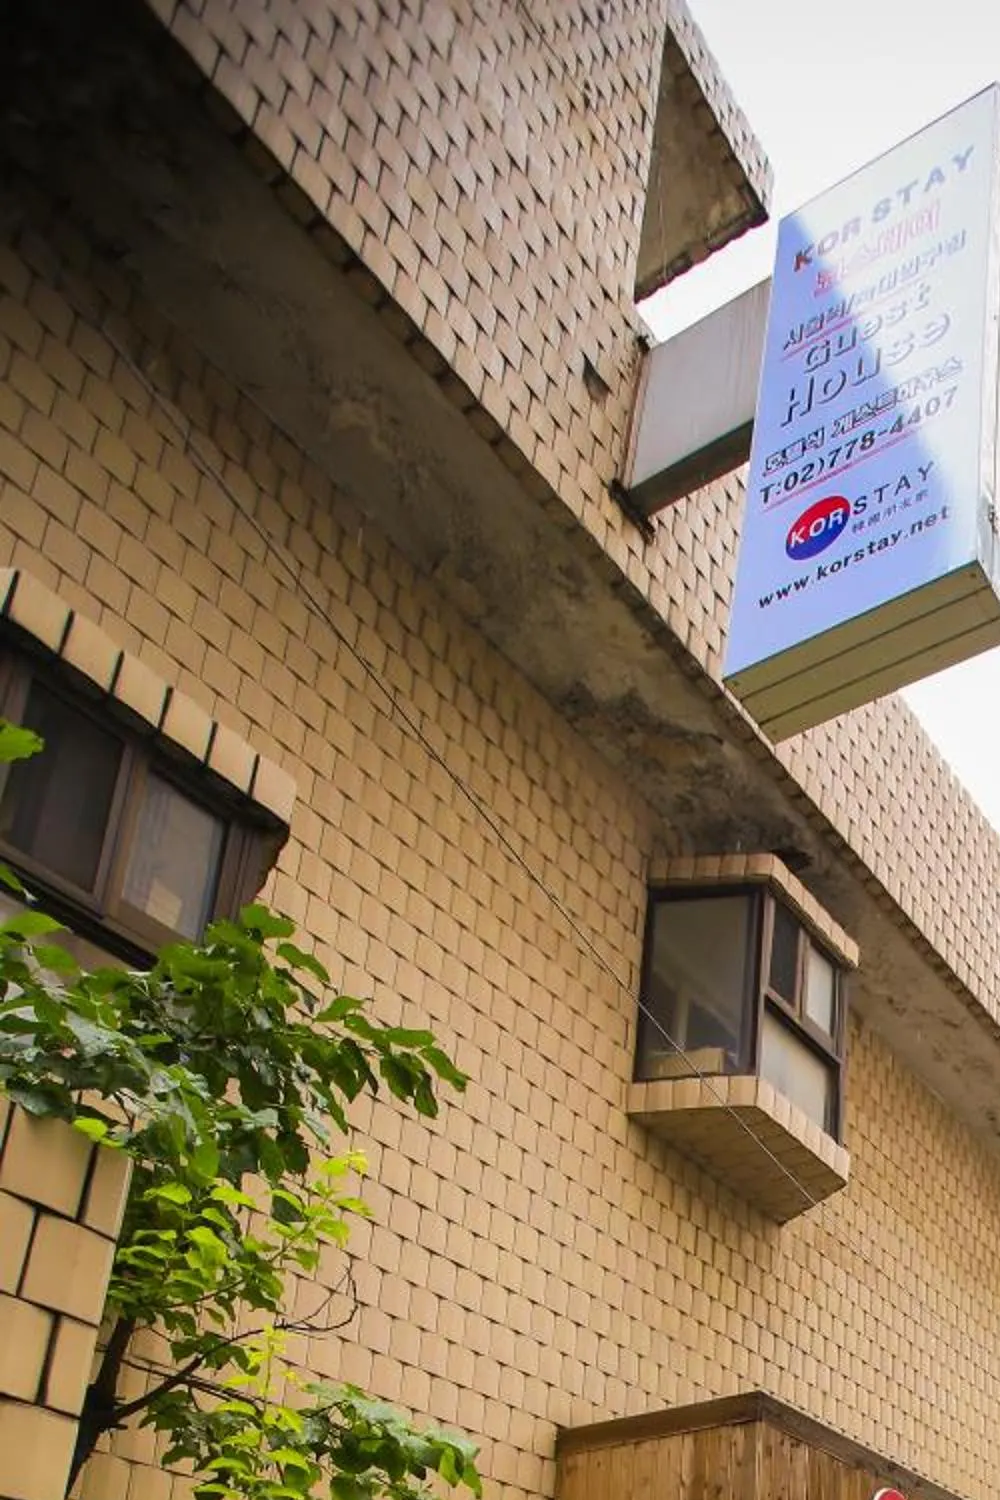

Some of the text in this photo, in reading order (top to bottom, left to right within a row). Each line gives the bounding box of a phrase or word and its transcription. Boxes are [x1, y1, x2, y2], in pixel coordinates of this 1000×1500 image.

[780, 311, 951, 427] House
[804, 281, 931, 373] Guest
[760, 385, 958, 504] T:02)778-4407
[758, 505, 949, 609] www.korstay.net
